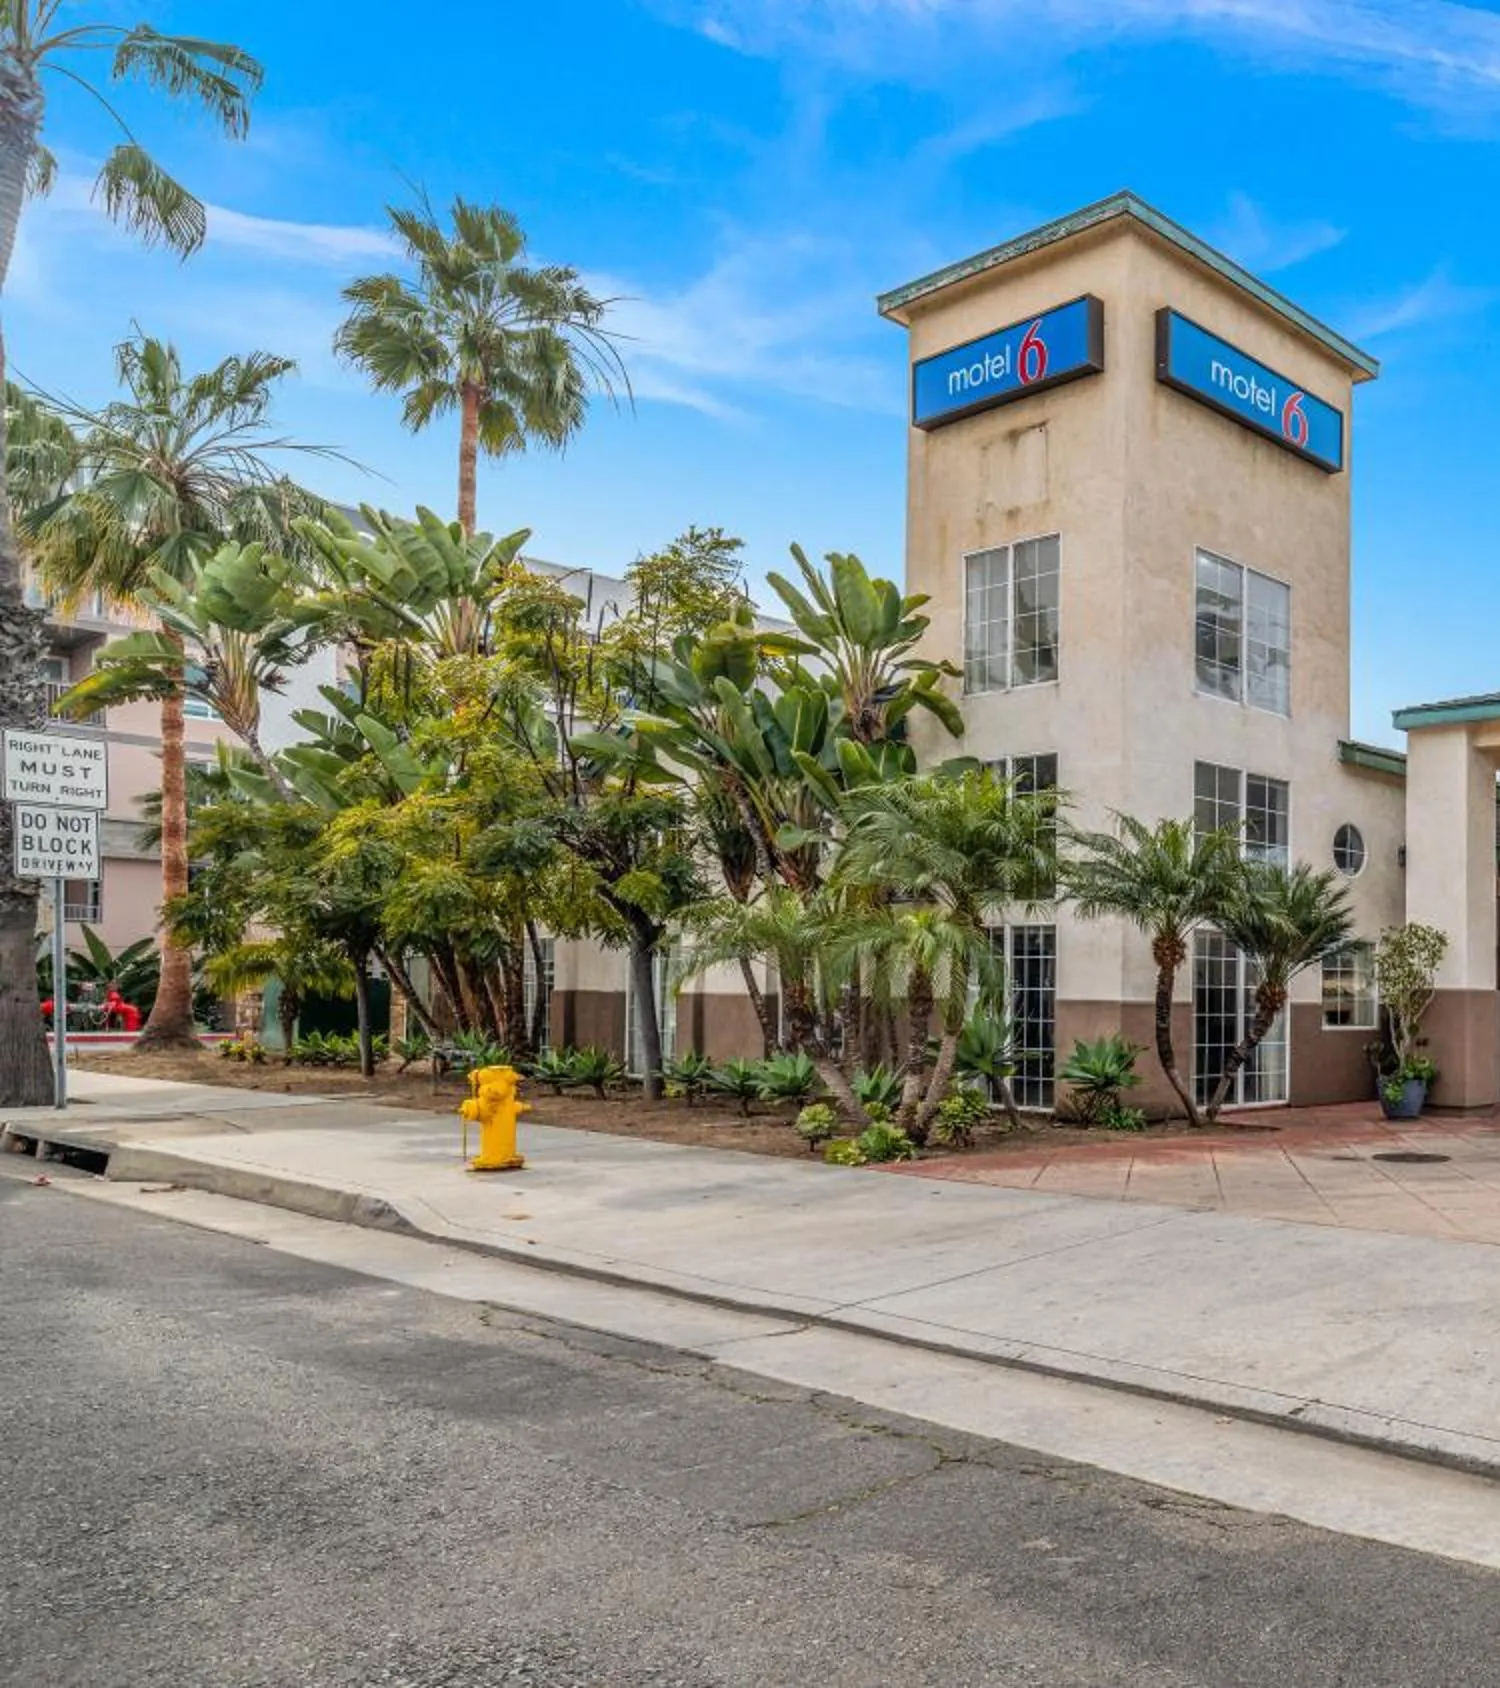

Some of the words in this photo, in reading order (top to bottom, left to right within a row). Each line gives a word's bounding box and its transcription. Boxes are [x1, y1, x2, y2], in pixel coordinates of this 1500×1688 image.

[949, 345, 1010, 395] motel
[1017, 318, 1048, 385] 6
[1210, 358, 1277, 417] motel
[1281, 389, 1309, 450] 6
[9, 739, 52, 754] RIGHT
[61, 746, 103, 761] LANE
[20, 760, 92, 779] MUST
[10, 779, 51, 794] TURN
[60, 785, 104, 799] RIGHT
[21, 812, 47, 831] DO
[57, 815, 91, 833] NOT
[22, 835, 92, 856] BLOCK
[21, 857, 93, 873] DRIVEWAY
